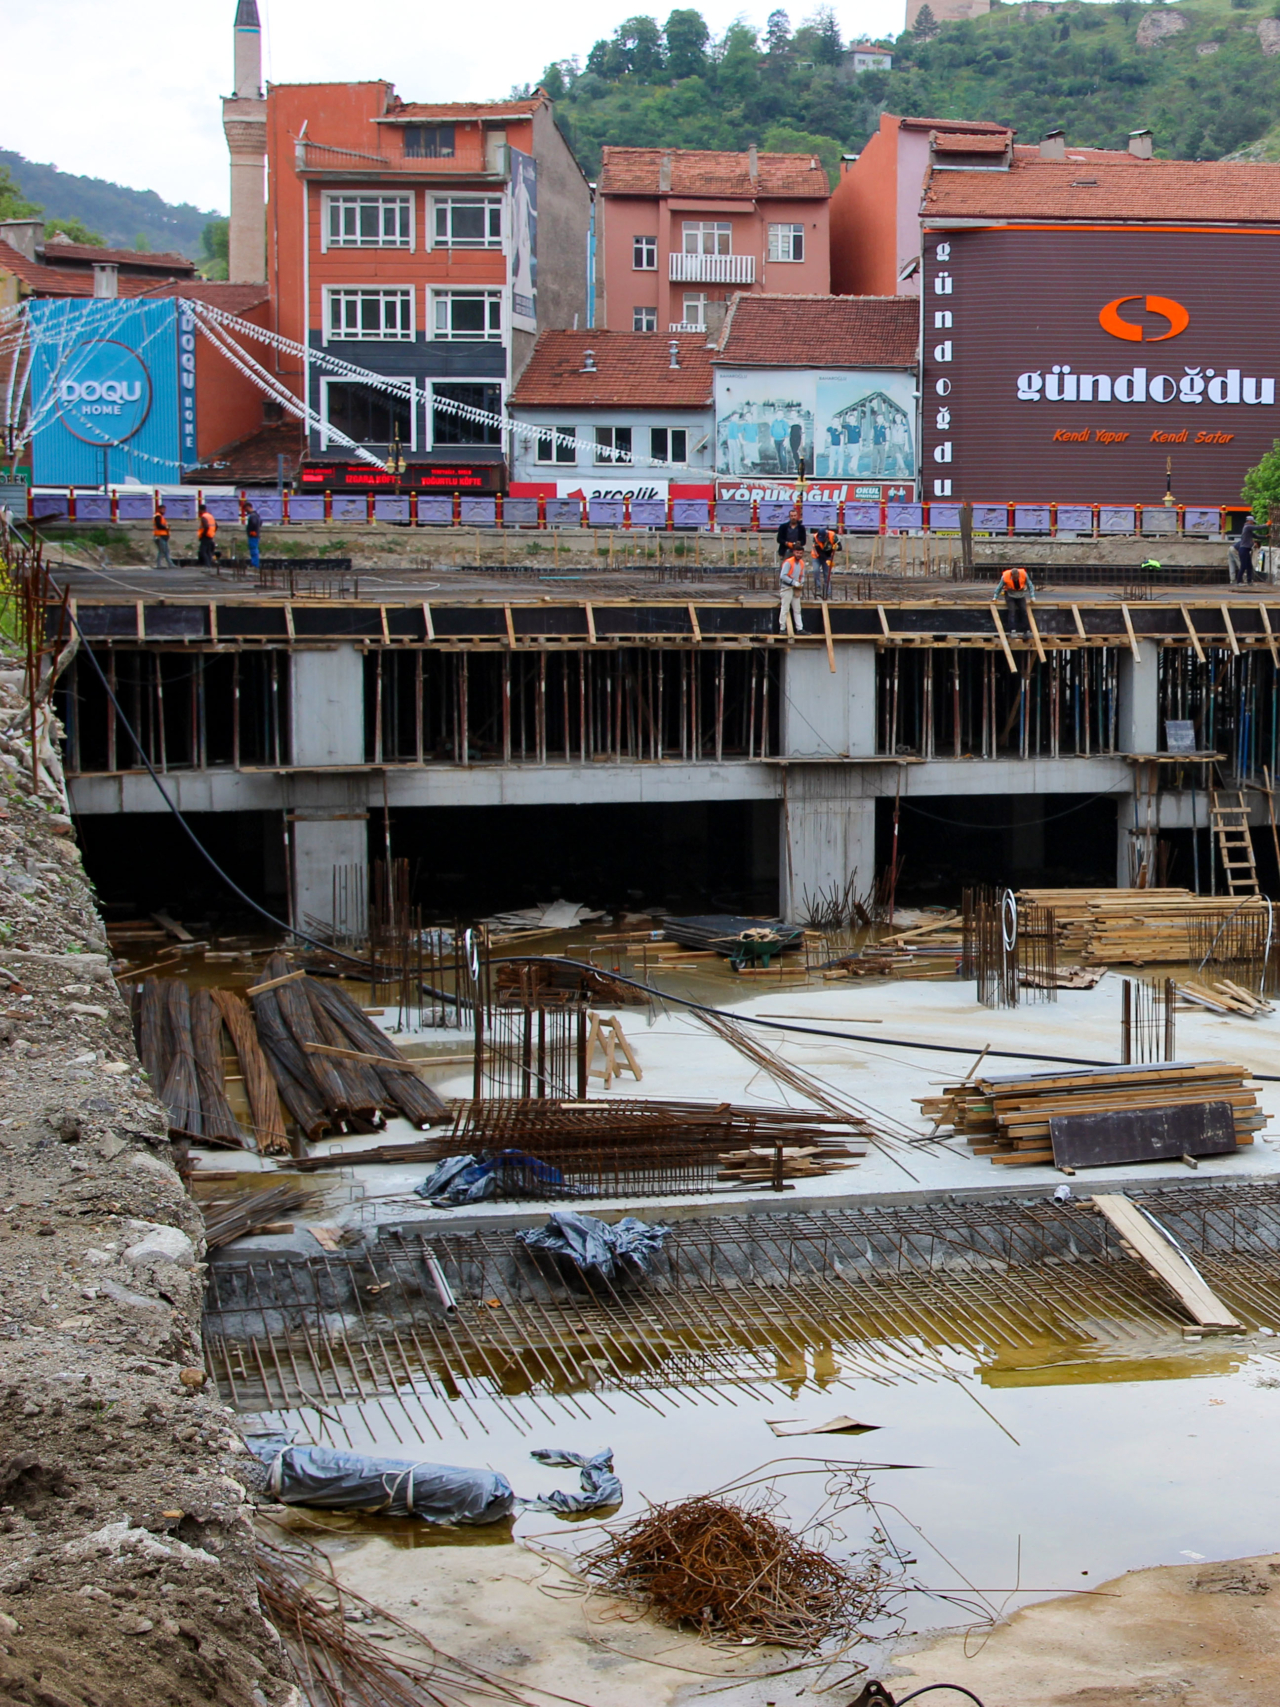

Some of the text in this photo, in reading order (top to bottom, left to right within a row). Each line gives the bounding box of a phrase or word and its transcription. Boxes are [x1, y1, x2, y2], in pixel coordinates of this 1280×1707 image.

[182, 313, 196, 448] DOQU HOME
[1017, 365, 1275, 405] gündoğdu
[61, 381, 142, 404] DOQU
[82, 405, 122, 415] HOME
[1053, 427, 1235, 444] Kendi Yapar Kendi Satar
